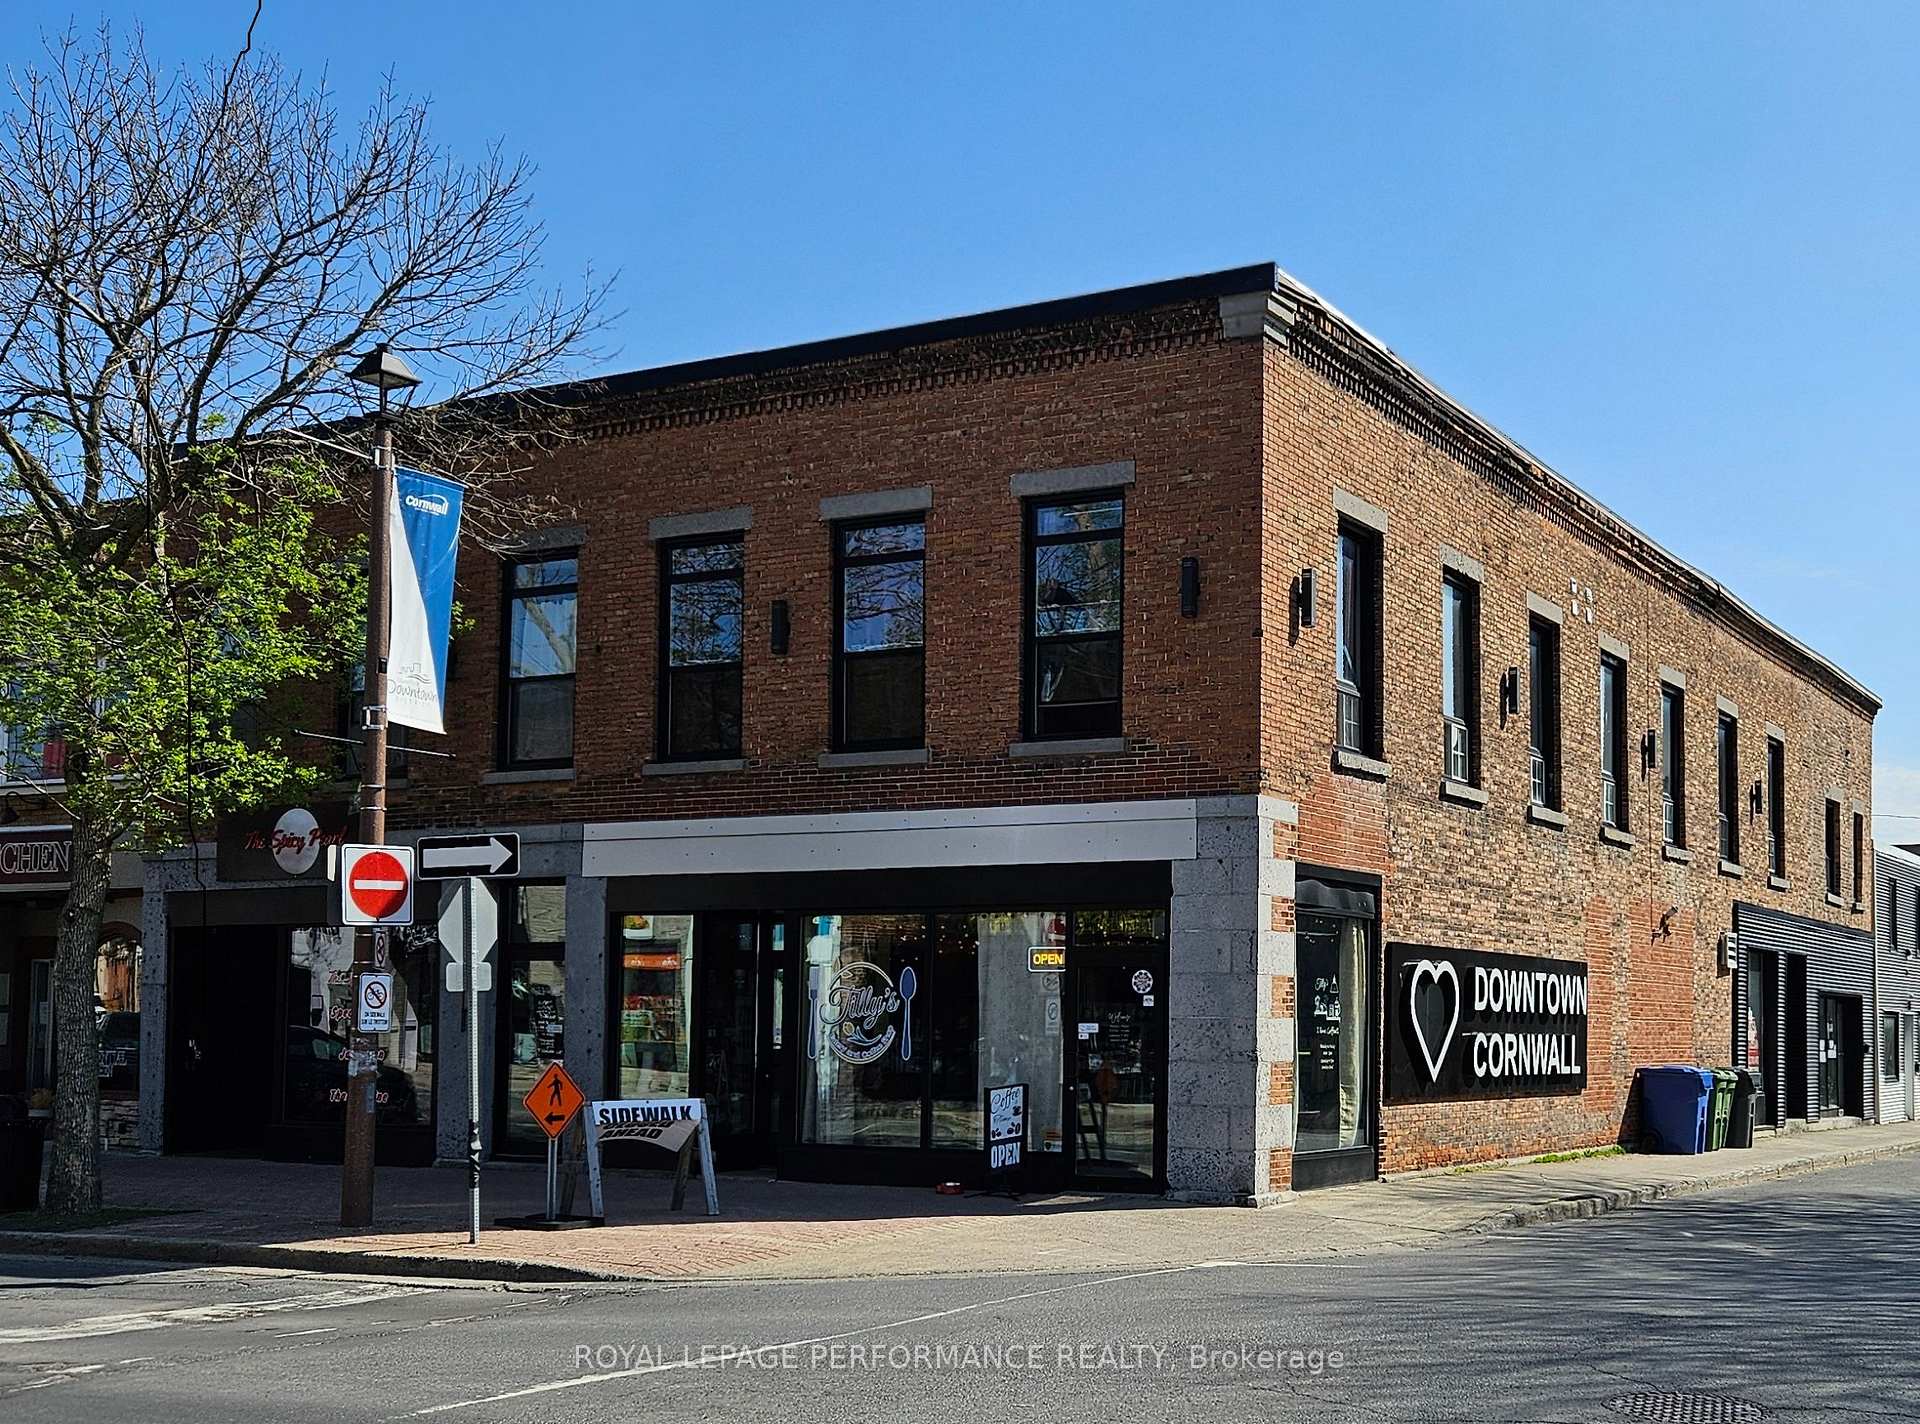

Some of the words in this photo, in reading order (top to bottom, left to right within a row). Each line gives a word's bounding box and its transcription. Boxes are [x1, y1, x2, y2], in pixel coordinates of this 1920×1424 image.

[0, 841, 72, 873] CHEN
[1032, 953, 1064, 965] OPEN
[1475, 966, 1587, 1015] DOWNTOWN
[819, 985, 900, 1030] Tilly's
[1474, 1032, 1581, 1077] CORNWALL
[599, 1105, 692, 1125] SIDEWALK
[991, 1088, 1020, 1114] Coffee
[599, 1128, 664, 1140] AHEAD
[991, 1141, 1021, 1169] OPEN
